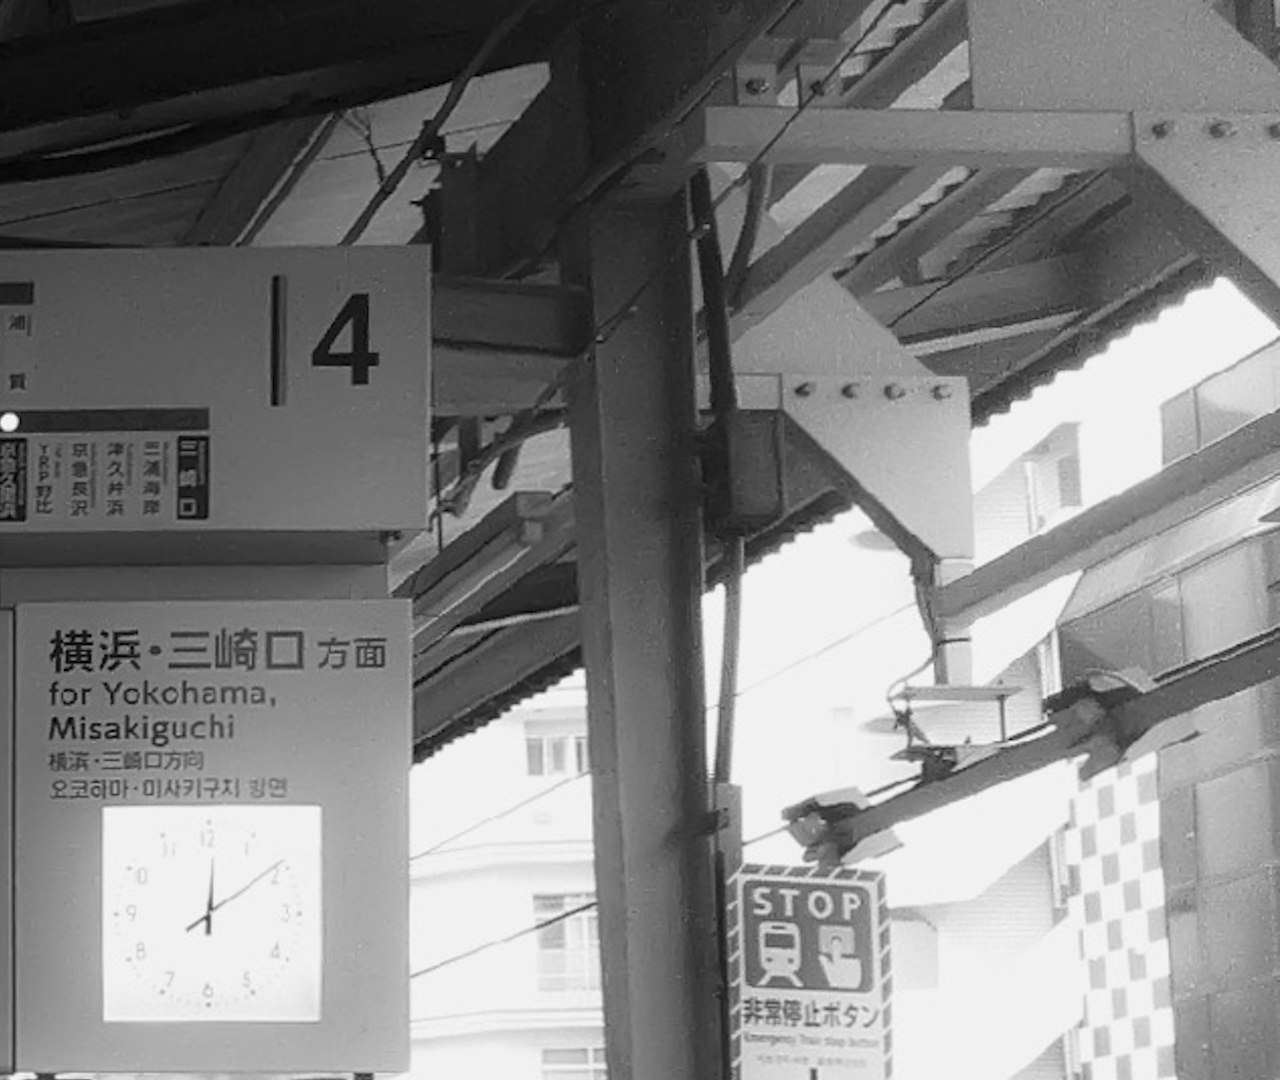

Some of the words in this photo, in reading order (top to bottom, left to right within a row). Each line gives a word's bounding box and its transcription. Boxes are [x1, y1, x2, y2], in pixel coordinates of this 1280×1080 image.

[312, 293, 379, 385] 4
[49, 628, 304, 673] 横浜・三崎口
[317, 636, 387, 672] 方面
[48, 682, 92, 707] for
[101, 680, 277, 708] Yokohama,
[47, 715, 235, 747] Misakiguchi
[752, 886, 862, 921] STOP
[743, 997, 880, 1029] 非常停止ボタン
